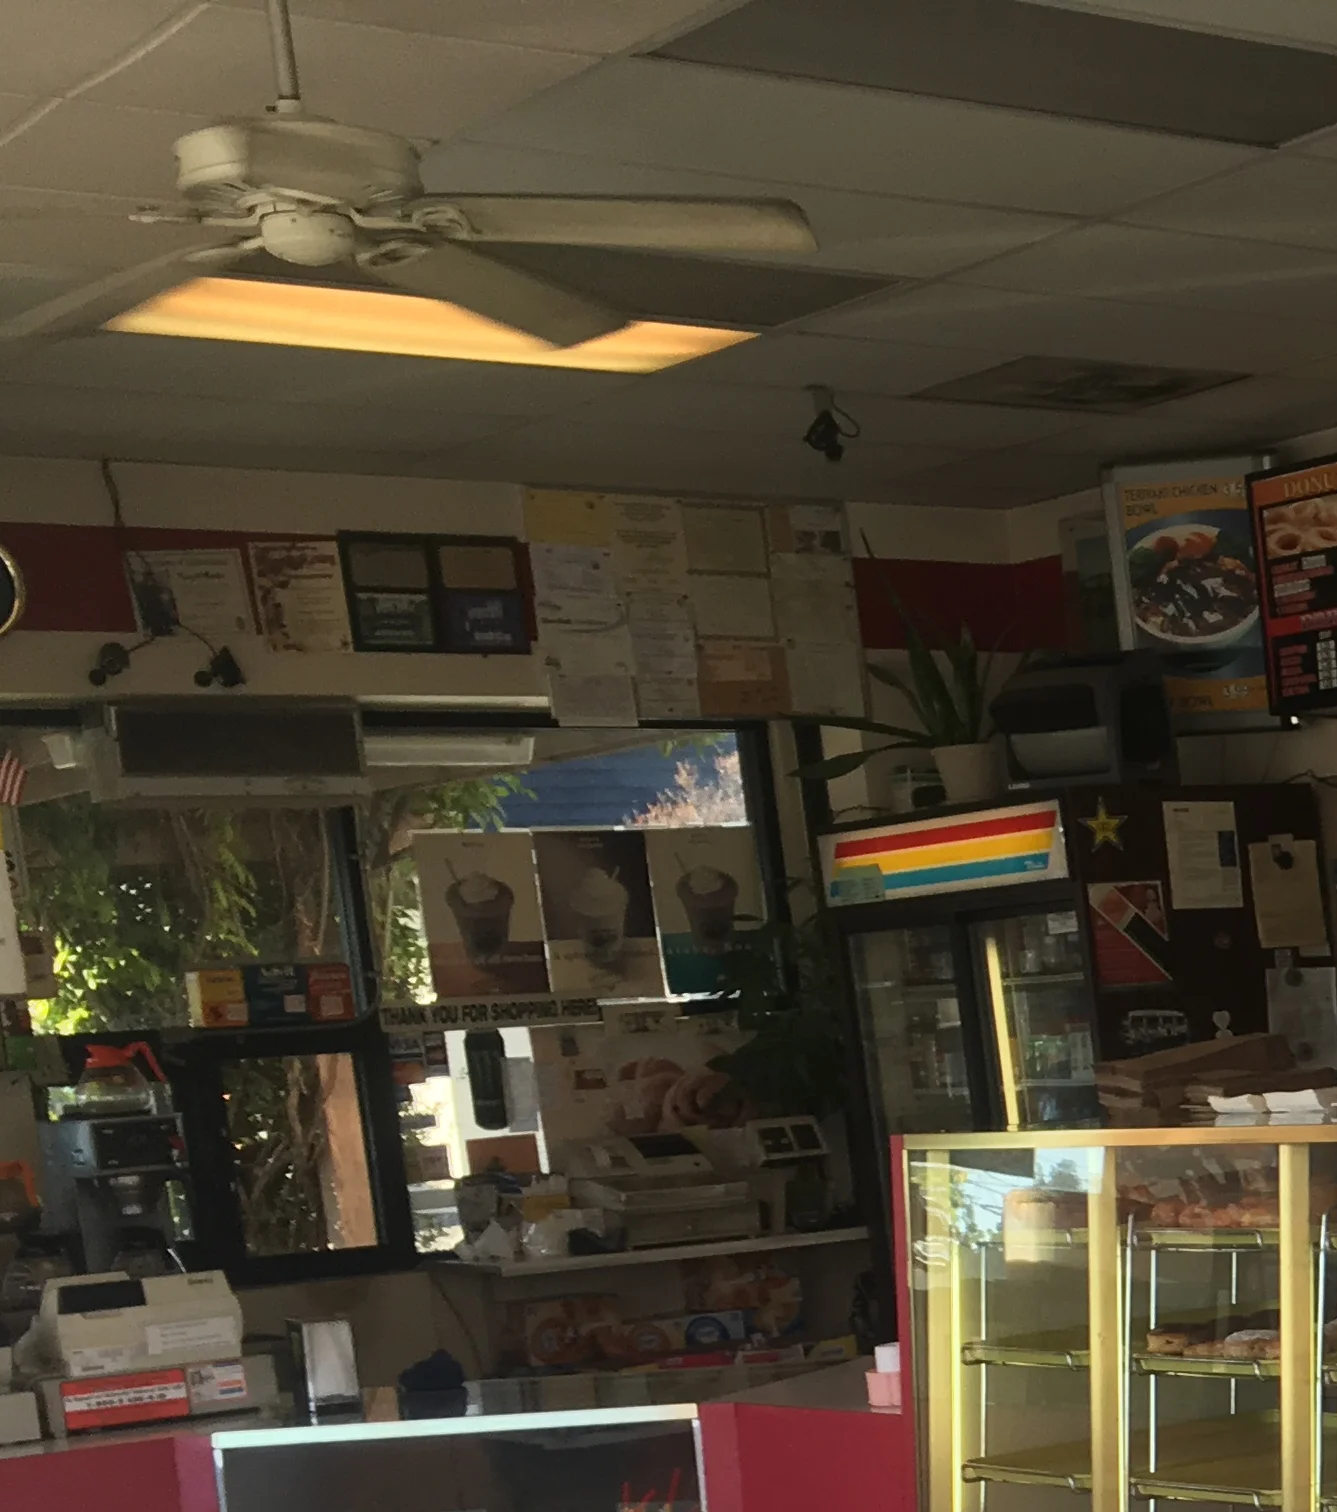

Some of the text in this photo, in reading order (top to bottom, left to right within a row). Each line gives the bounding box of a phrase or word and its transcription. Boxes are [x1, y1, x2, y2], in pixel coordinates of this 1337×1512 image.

[381, 1005, 426, 1026] THANK
[431, 1004, 459, 1024] YOU
[462, 1002, 488, 1023] FOR
[490, 999, 558, 1021] SHOPPING
